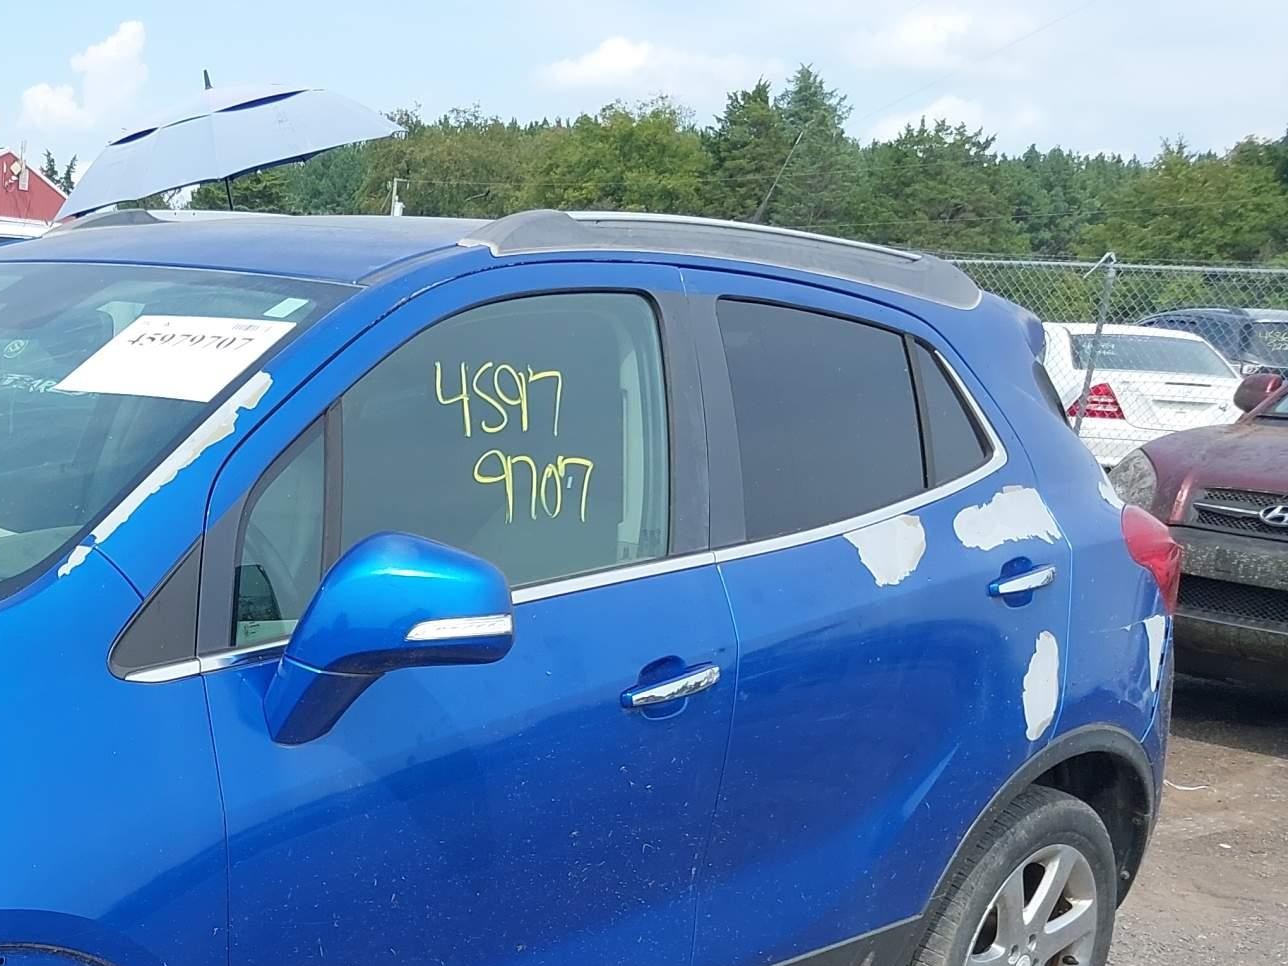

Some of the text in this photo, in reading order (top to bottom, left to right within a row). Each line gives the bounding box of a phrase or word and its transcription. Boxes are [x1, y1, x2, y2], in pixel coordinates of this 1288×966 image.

[127, 332, 256, 350] 45979707
[434, 361, 562, 438] 4597
[473, 449, 594, 525] 9707
